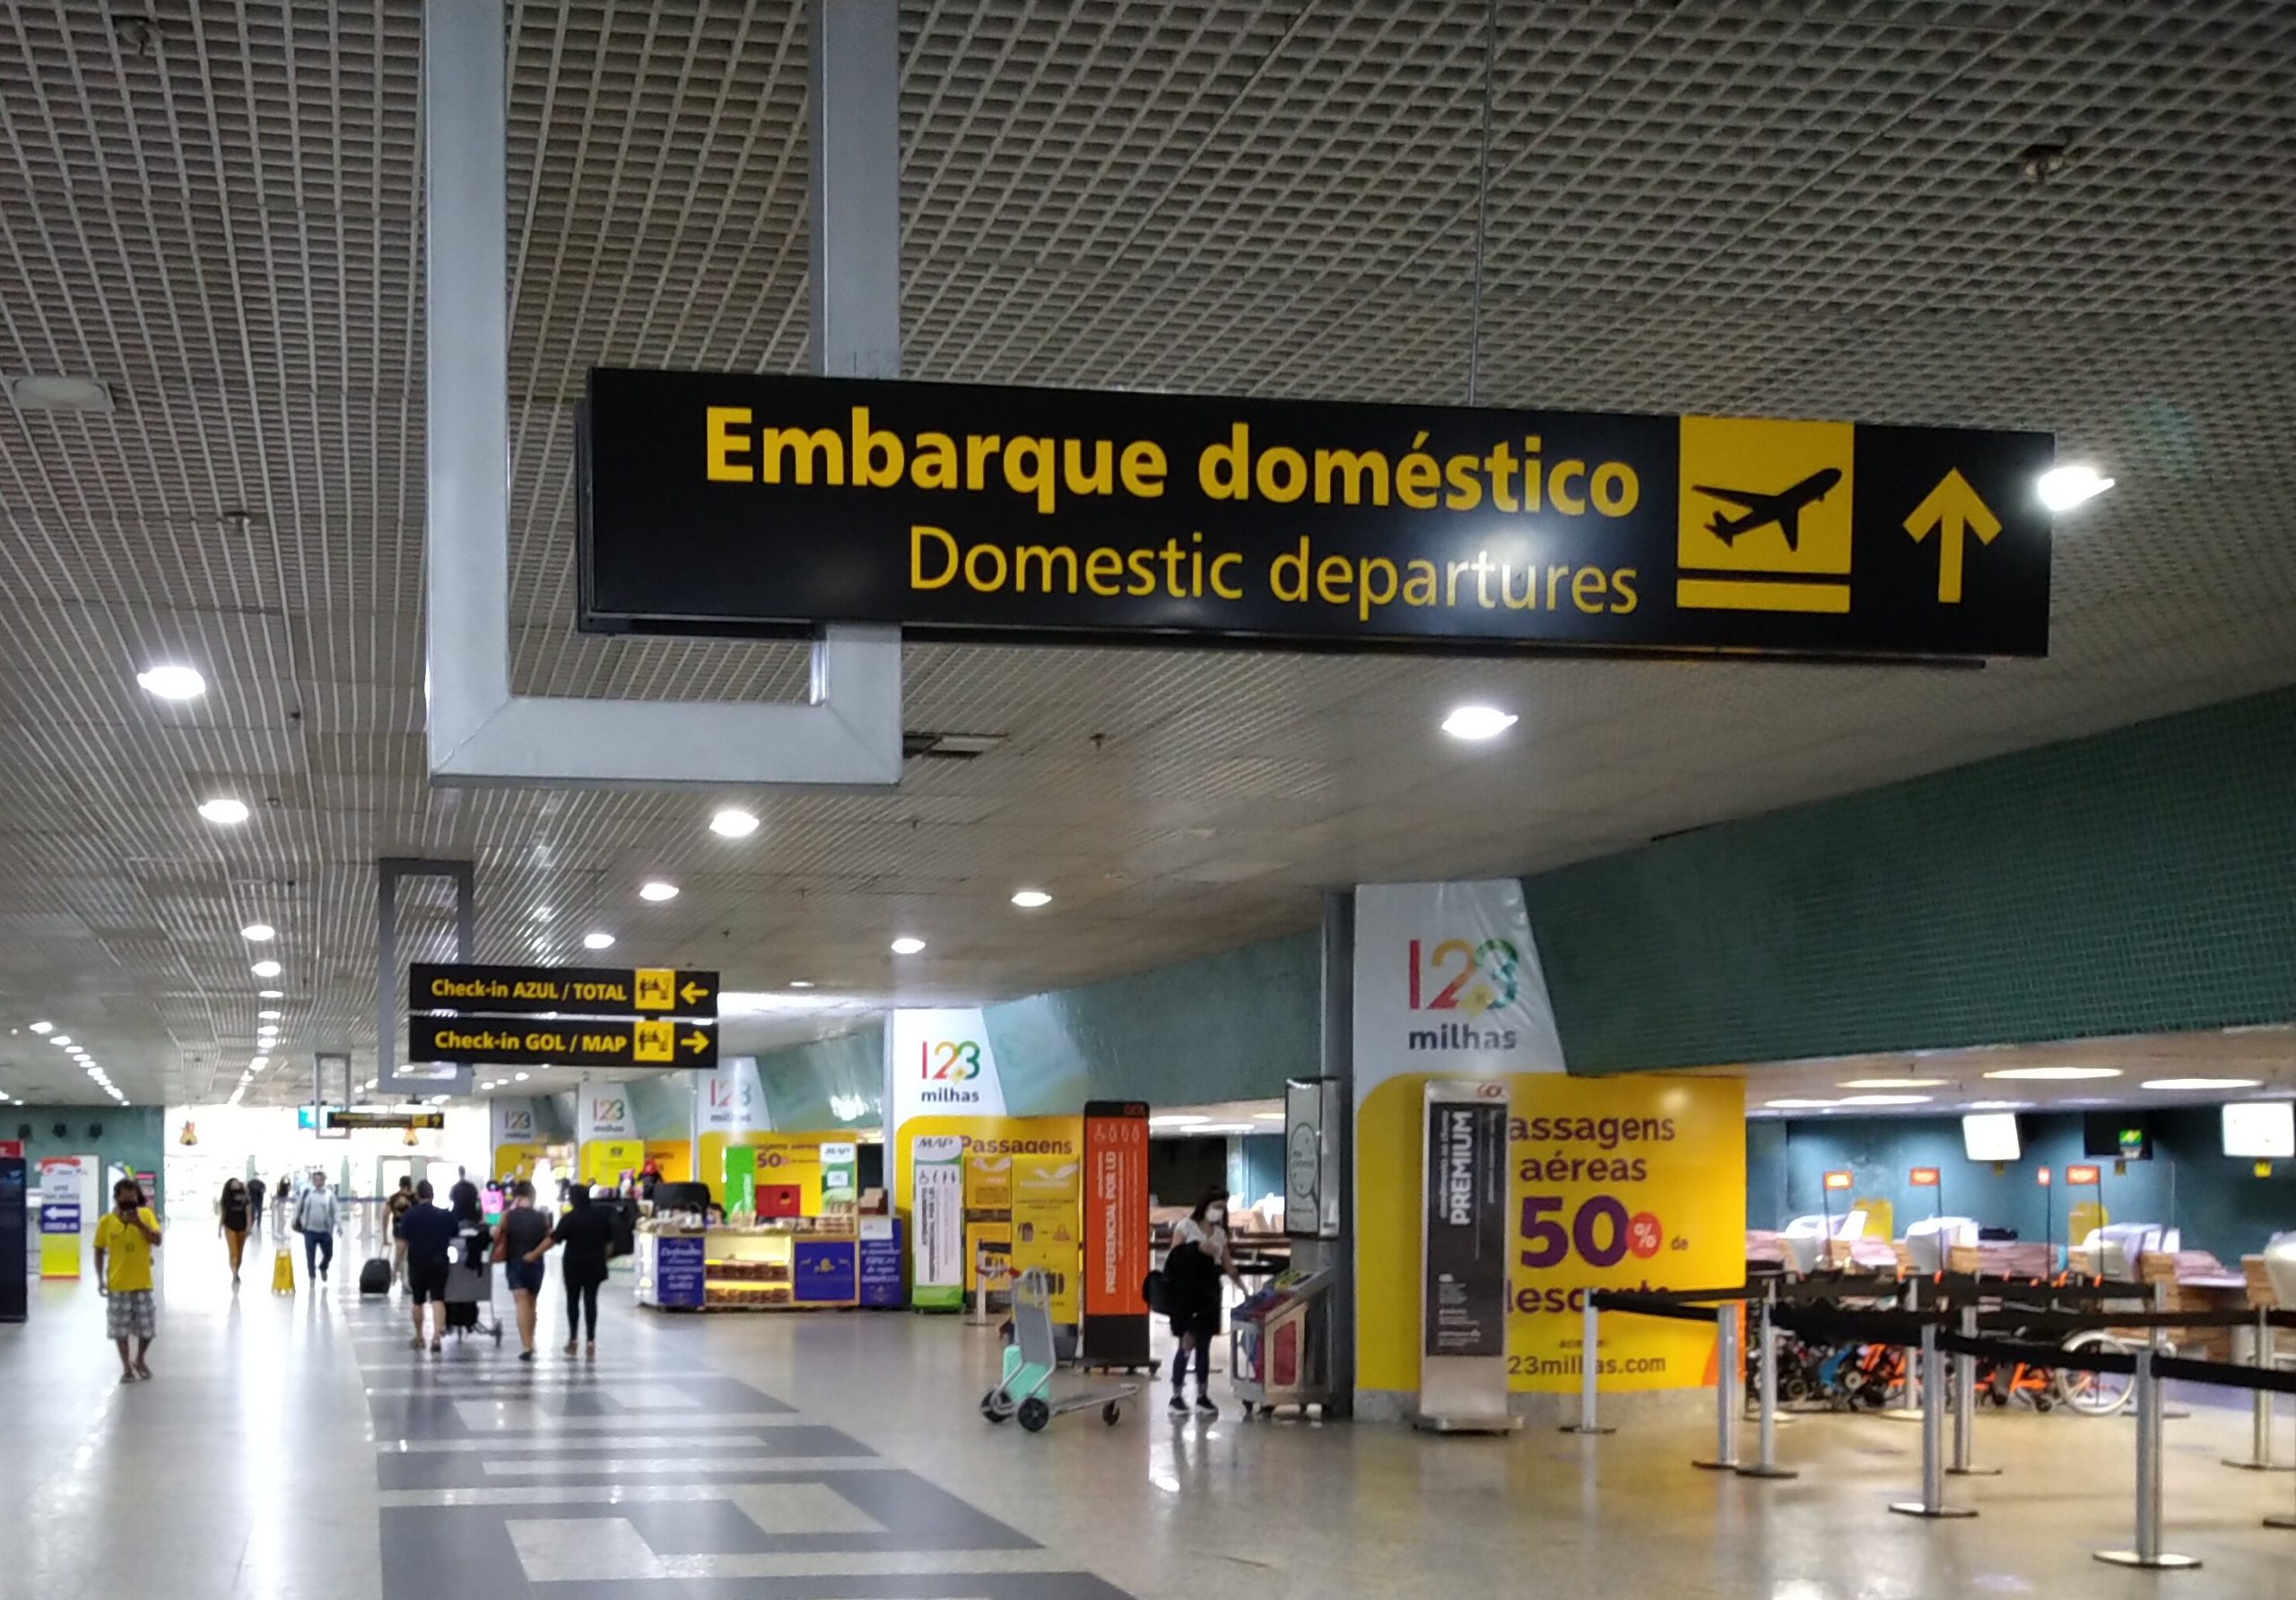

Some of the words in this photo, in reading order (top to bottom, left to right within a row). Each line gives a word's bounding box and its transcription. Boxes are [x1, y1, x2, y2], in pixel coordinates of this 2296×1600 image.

[706, 406, 1168, 513] Embarque
[1198, 422, 1640, 517] doméstico
[910, 525, 1243, 600] Domestic
[1269, 535, 1639, 622] departures
[1408, 938, 1519, 1010] 123
[431, 978, 509, 999] Check-in
[512, 981, 559, 1000] AZUL
[561, 981, 570, 1002] /
[573, 983, 628, 1002] TOTAL
[434, 1030, 519, 1051] Check-in
[525, 1032, 566, 1052] GOL
[569, 1033, 578, 1054] /
[582, 1035, 627, 1053] MAP
[1408, 1023, 1517, 1050] milhas
[921, 1040, 980, 1080] 123
[592, 1098, 625, 1121] 123
[921, 1088, 979, 1102] milhas
[960, 1135, 1073, 1155] Passagens
[1509, 1117, 1676, 1150] assagens
[1450, 1111, 1473, 1226] PREMIUM
[1520, 1150, 1648, 1182] aéreas
[1508, 1355, 1666, 1376] 23milas.com
